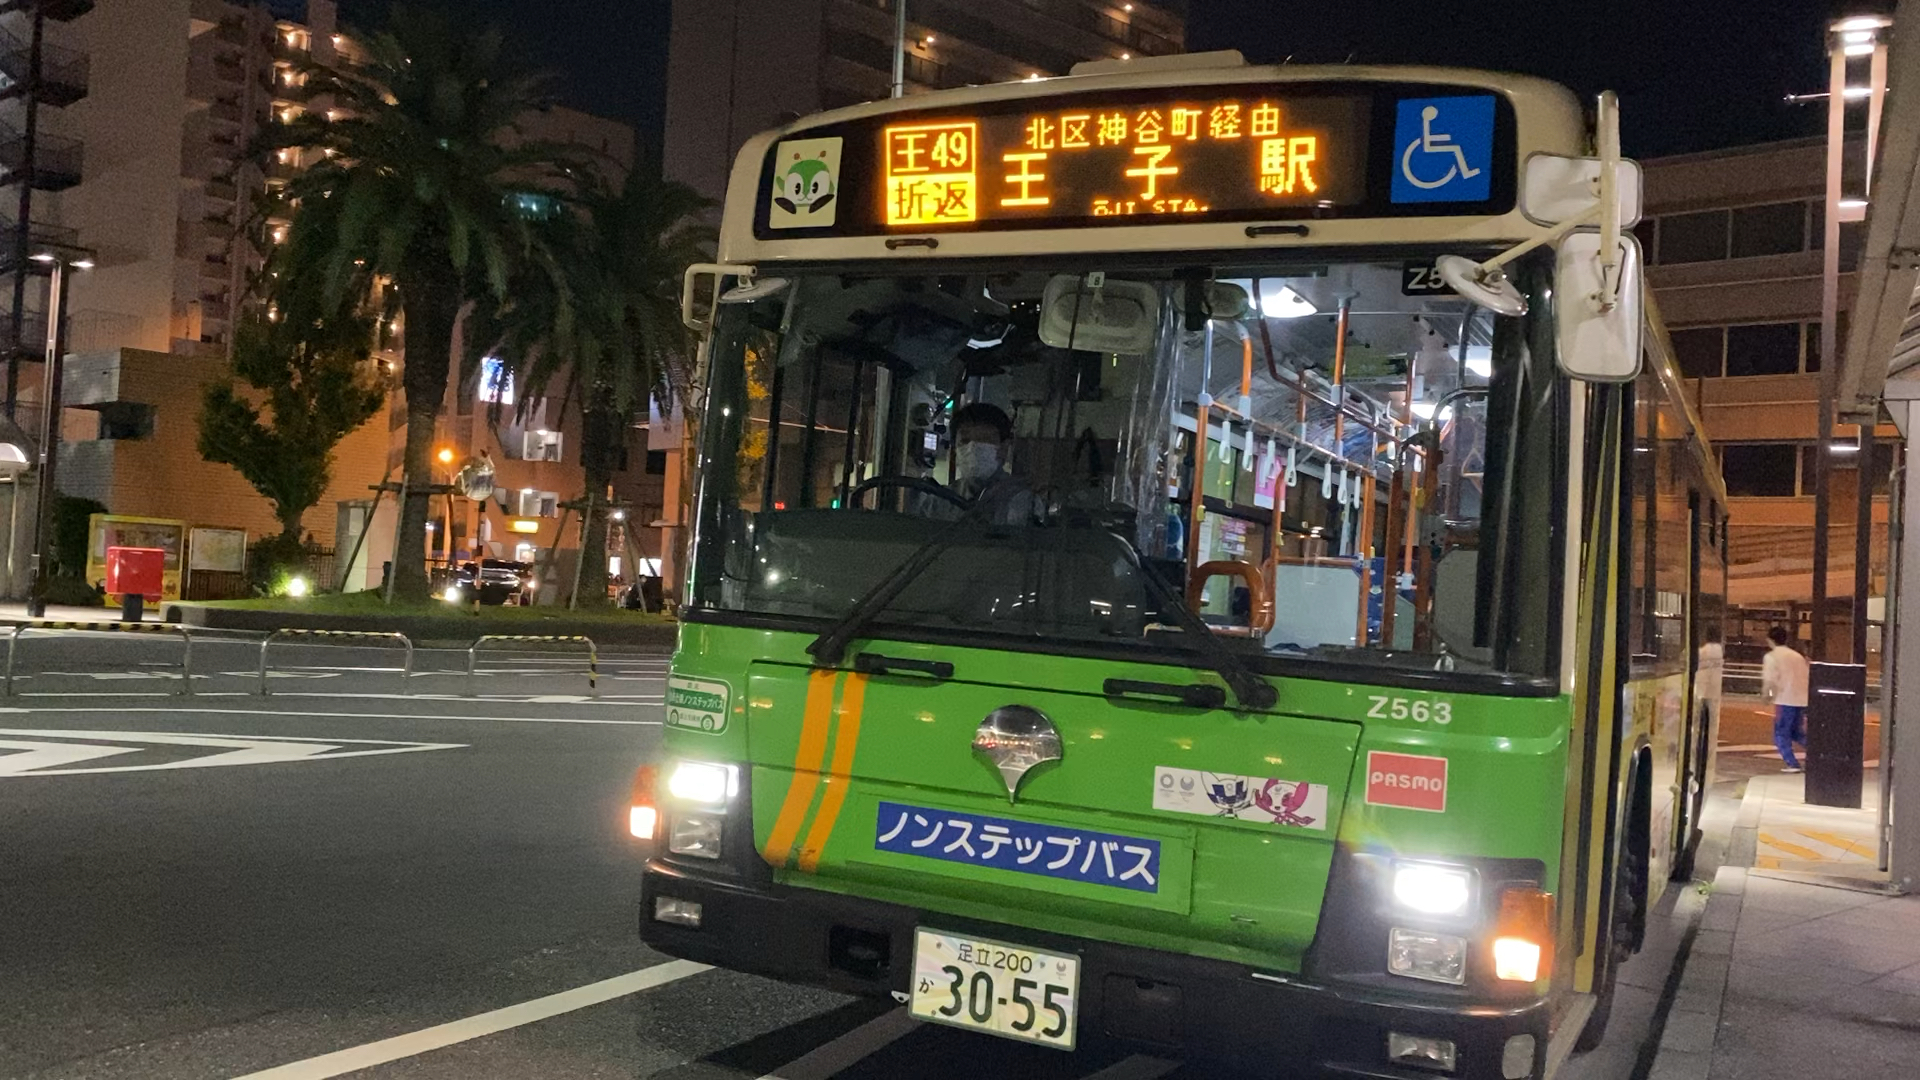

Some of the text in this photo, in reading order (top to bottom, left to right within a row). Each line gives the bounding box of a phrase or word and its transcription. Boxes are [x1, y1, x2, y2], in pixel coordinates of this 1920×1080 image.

[1025, 102, 1280, 150] 北区神谷町経由
[893, 131, 968, 173] 王49
[894, 180, 969, 219] 折返
[1366, 695, 1453, 725] Z563
[1370, 771, 1443, 792] PASMO
[878, 811, 1156, 885] ノンステップバス
[957, 943, 1033, 974] 足立200
[918, 965, 1070, 1039] か 30-55
